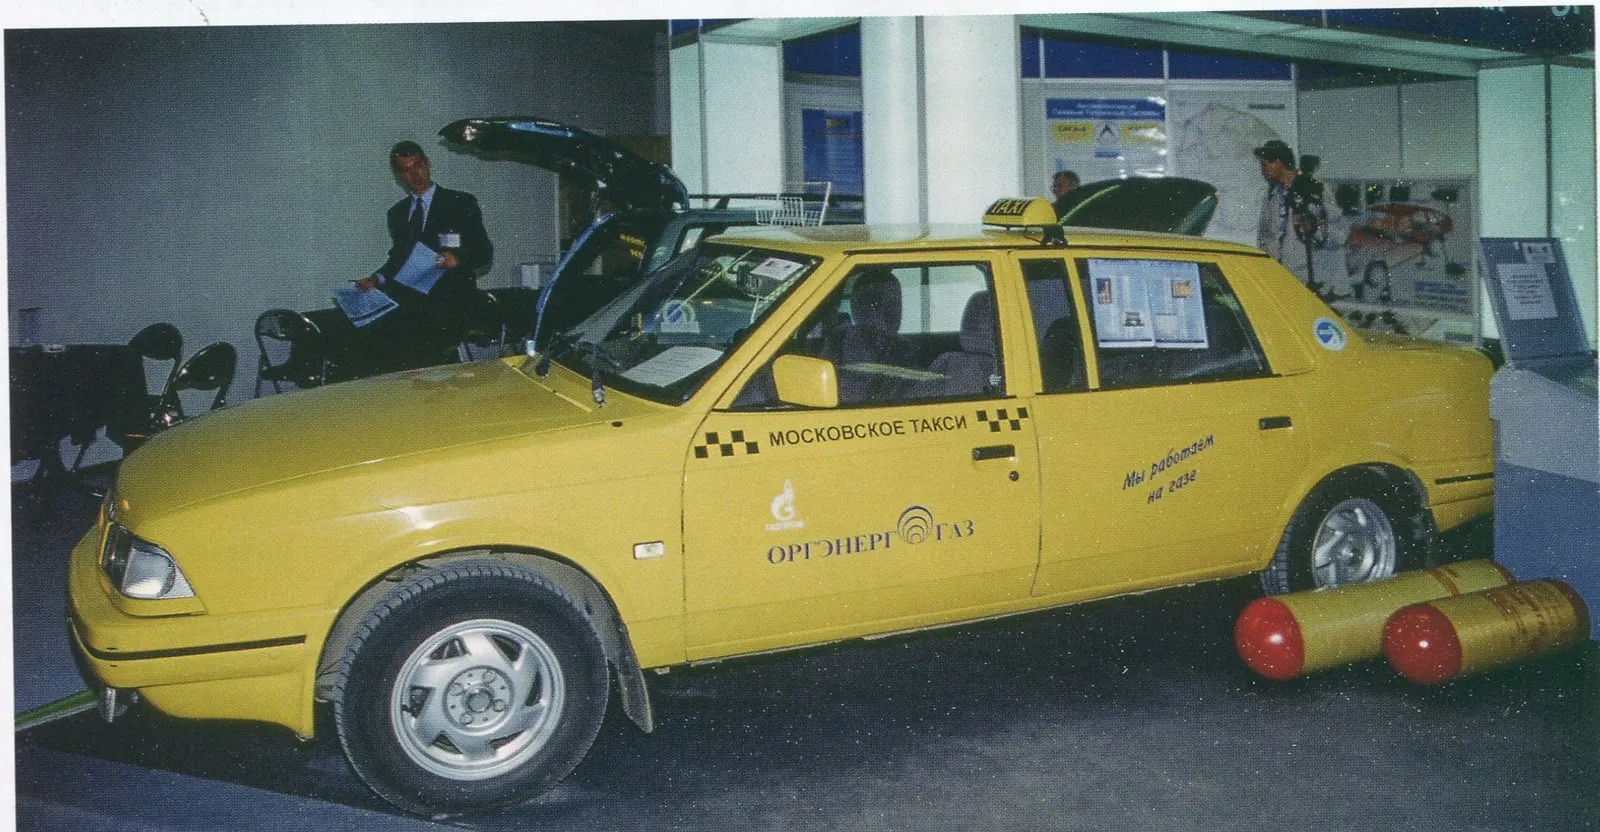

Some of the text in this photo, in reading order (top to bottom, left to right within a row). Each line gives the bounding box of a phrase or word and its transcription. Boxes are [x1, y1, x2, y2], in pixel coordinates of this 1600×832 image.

[989, 199, 1029, 214] TAXI
[769, 414, 968, 447] МОСКОВСКОЕ ТАКСИ
[1122, 434, 1215, 490] Мы работаем
[1147, 469, 1196, 504] на газе
